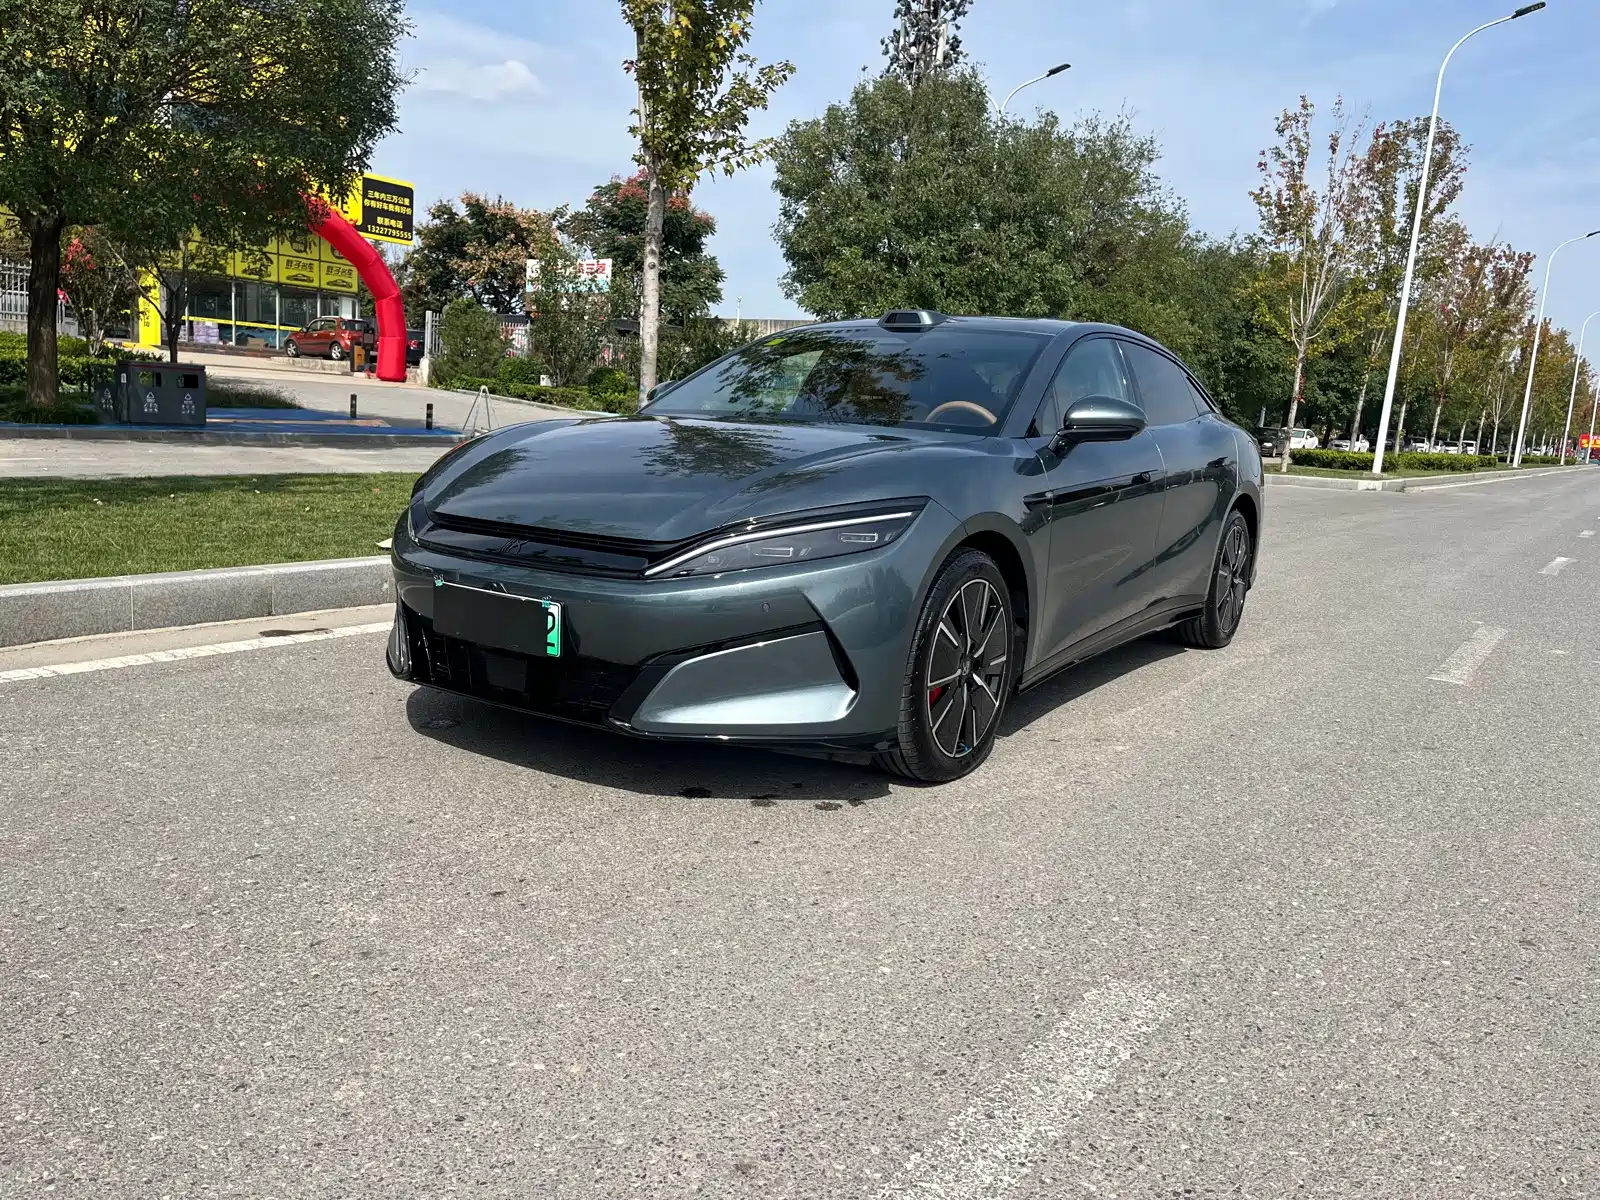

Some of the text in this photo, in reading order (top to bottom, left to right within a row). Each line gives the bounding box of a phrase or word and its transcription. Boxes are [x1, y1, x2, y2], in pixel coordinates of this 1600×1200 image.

[367, 190, 410, 206] 三年内三万公里
[376, 216, 404, 229] 联系电话
[367, 225, 412, 239] 13227795555
